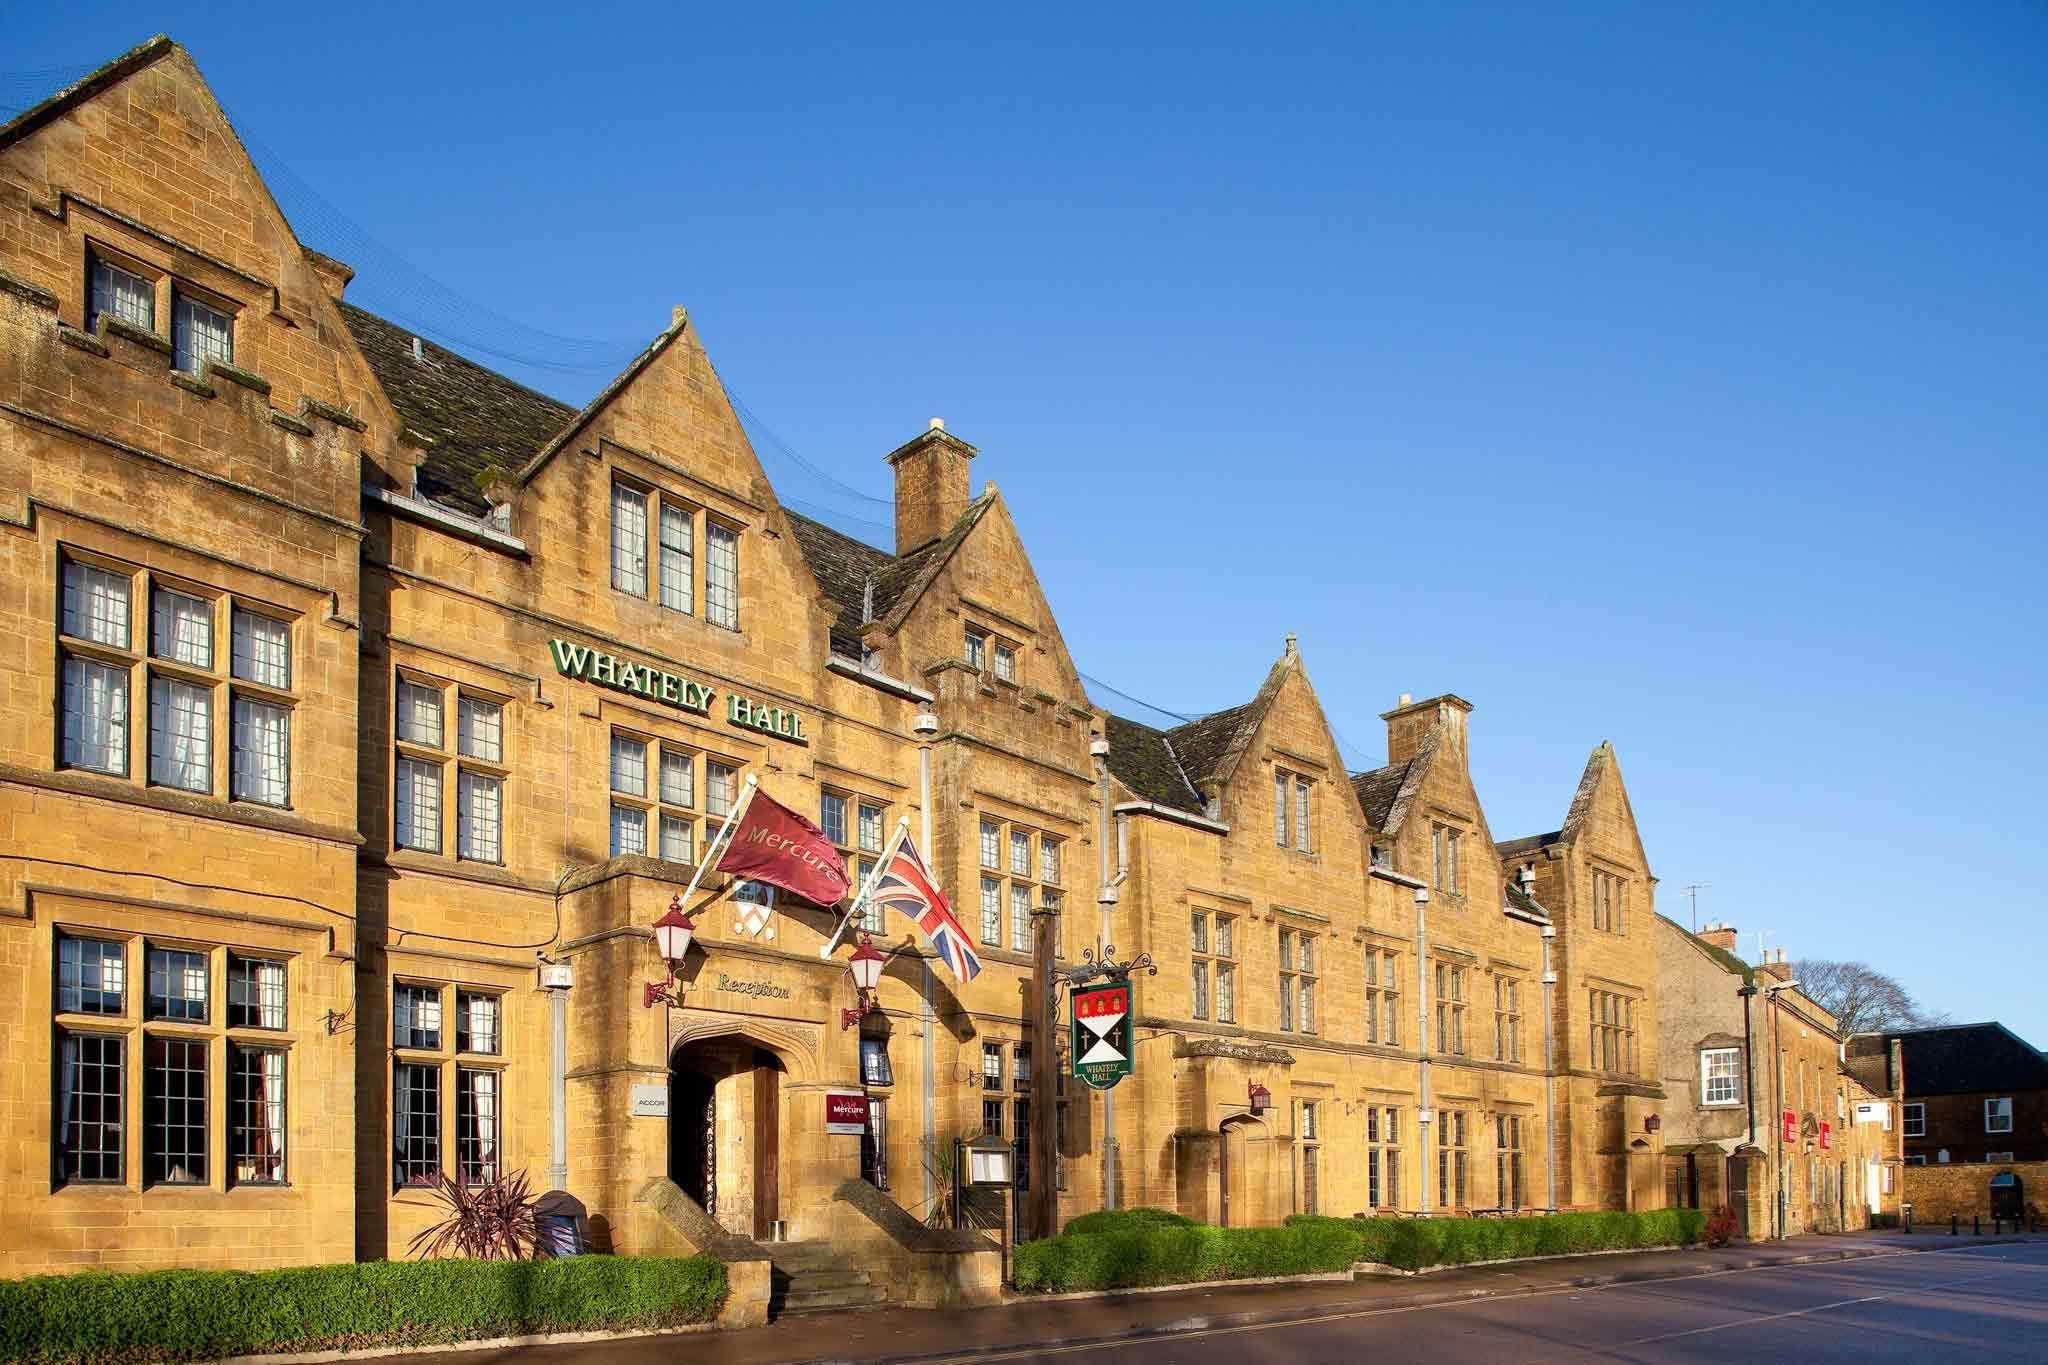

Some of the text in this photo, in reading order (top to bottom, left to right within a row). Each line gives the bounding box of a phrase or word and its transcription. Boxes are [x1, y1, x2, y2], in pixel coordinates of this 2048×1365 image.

[549, 639, 808, 742] WHATELY HALL
[747, 825, 840, 881] Mercure
[718, 974, 790, 999] Reception
[1087, 1063, 1119, 1081] WHATELY HALL
[833, 1105, 864, 1114] Mercure
